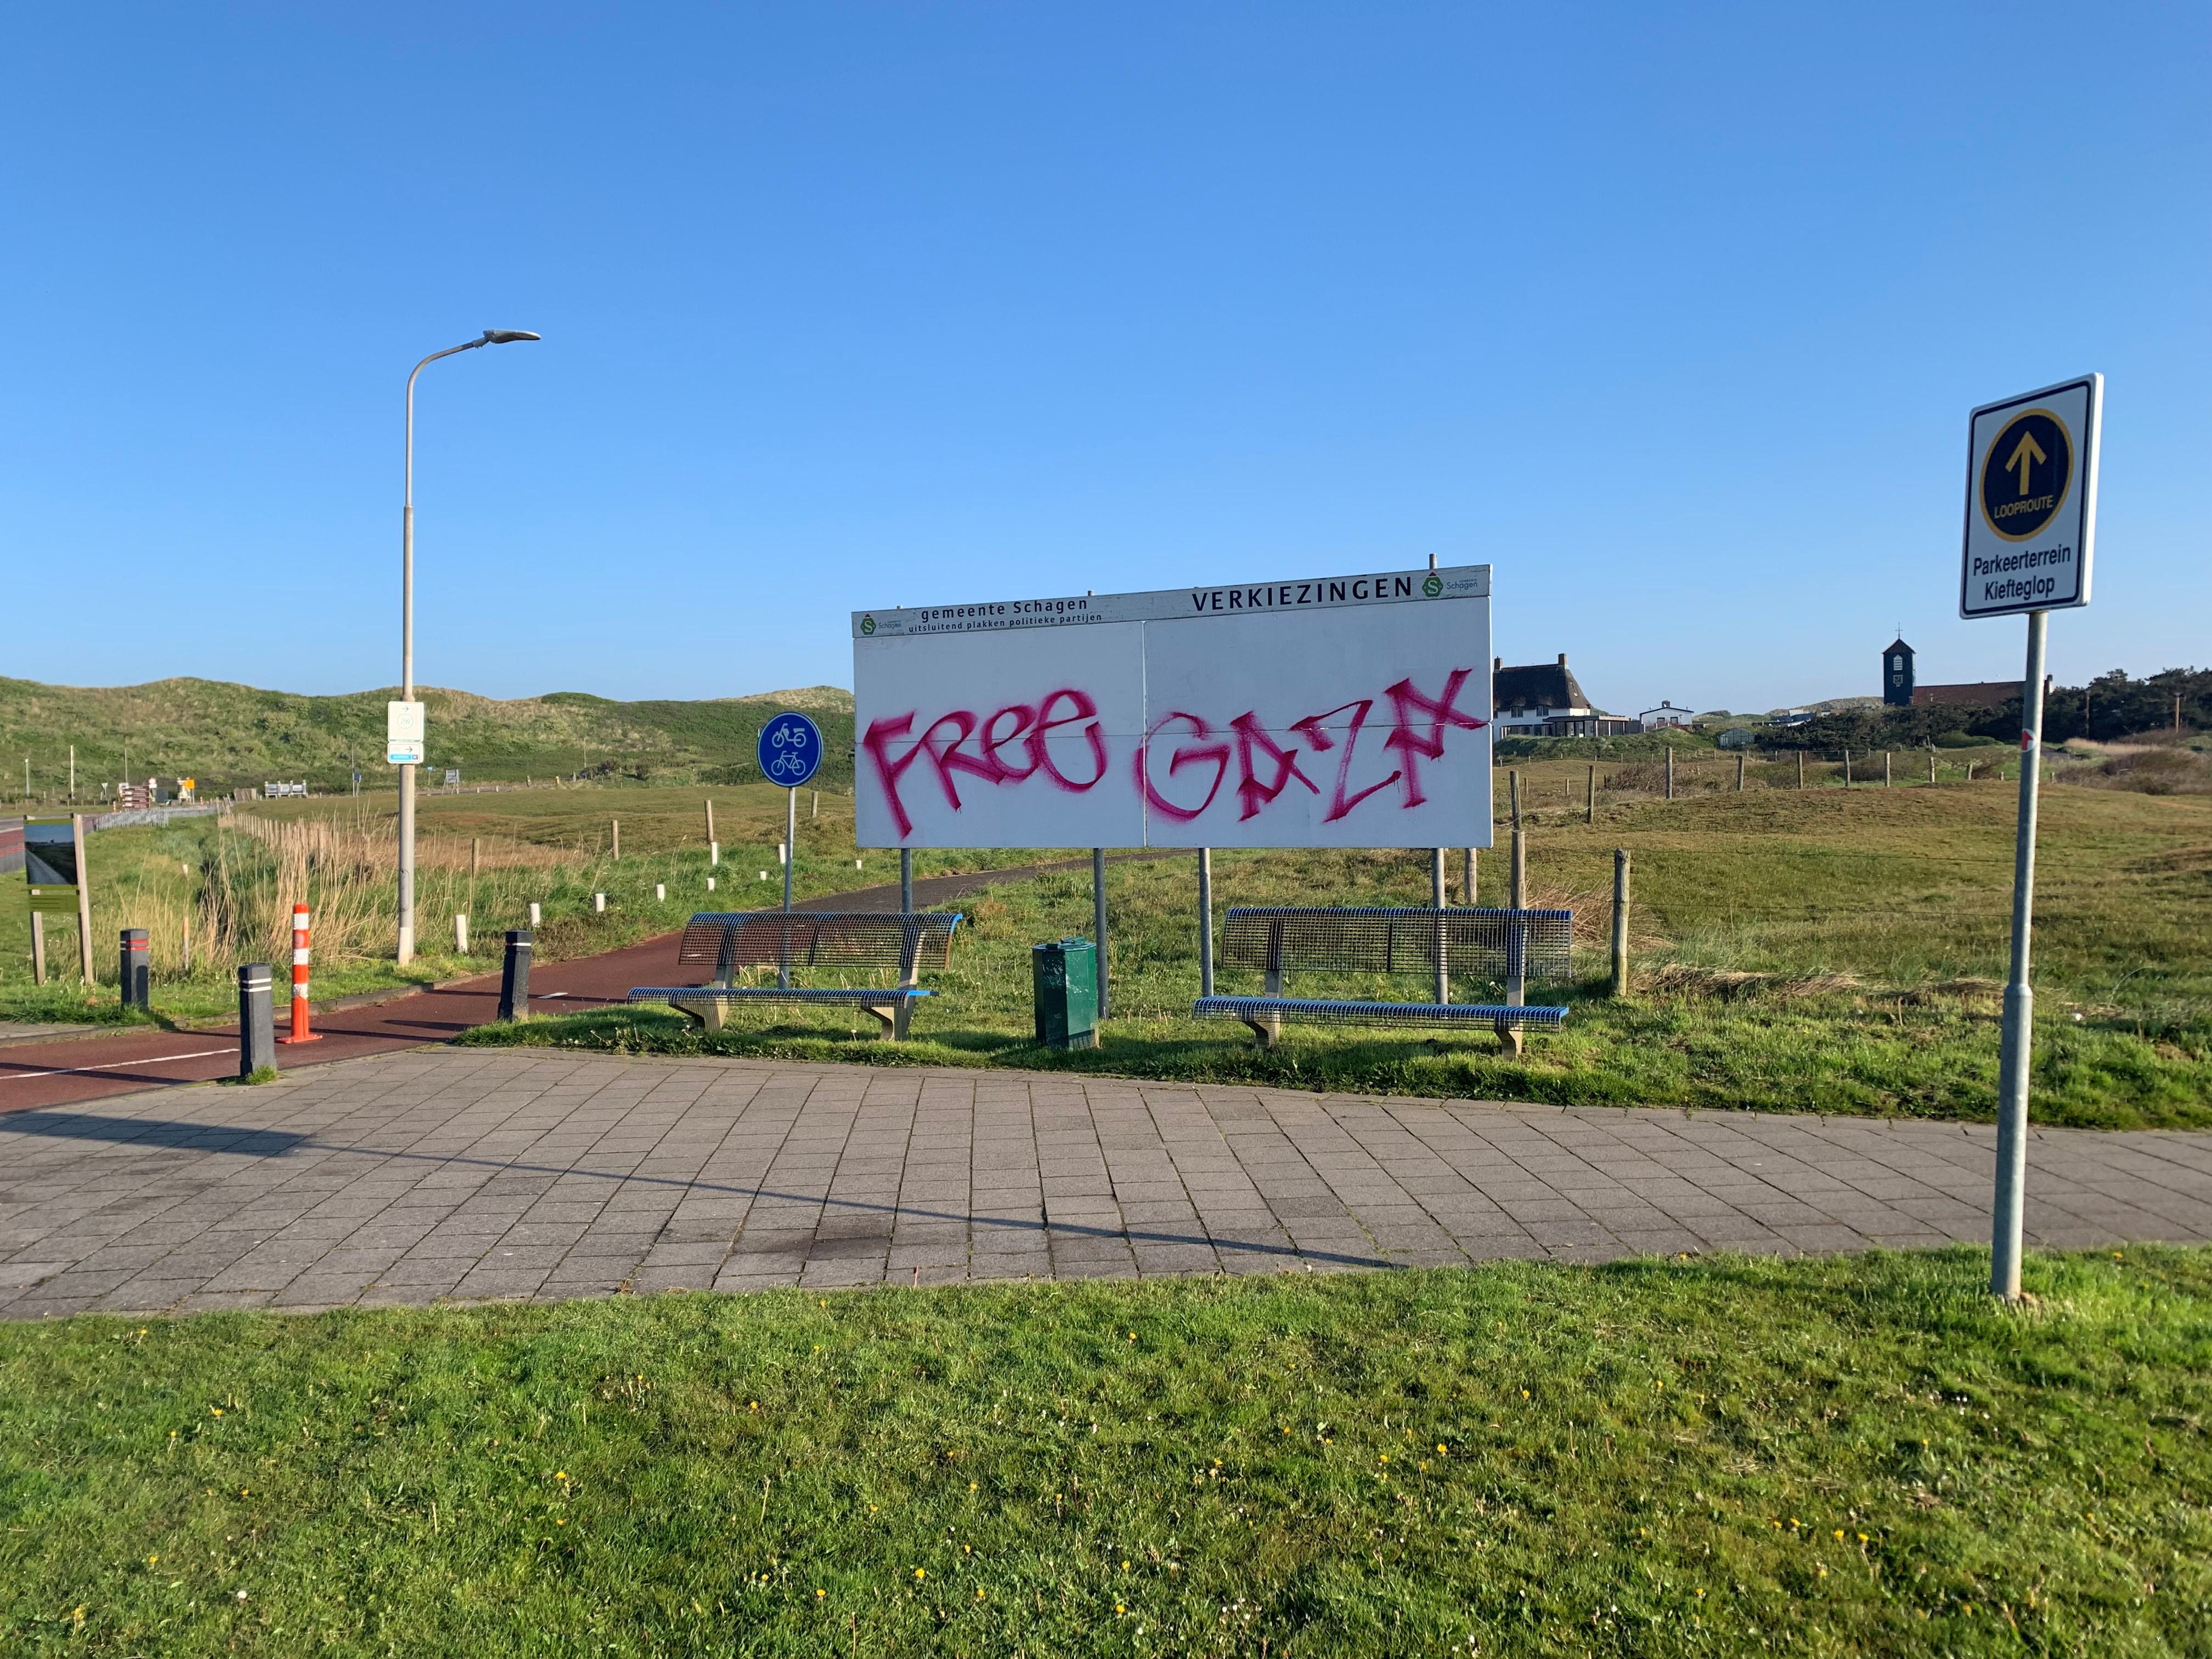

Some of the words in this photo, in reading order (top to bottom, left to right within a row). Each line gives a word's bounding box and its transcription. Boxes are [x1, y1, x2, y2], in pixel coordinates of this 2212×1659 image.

[1994, 495, 2053, 519] LOOPROUTE
[1974, 544, 2071, 577] Parkeerterrein
[1192, 577, 1411, 611] VERKIEZINGEN
[1447, 581, 1477, 590] Schagen
[1985, 575, 2055, 601] Kiefteglop
[909, 622, 963, 633] uitsluitend
[967, 619, 1005, 630] plakken
[1009, 616, 1056, 627] politieke
[1059, 613, 1102, 624] partijen
[921, 605, 1006, 623] gemeente
[1013, 598, 1087, 615] Schagen
[1135, 668, 1486, 822] GAZA
